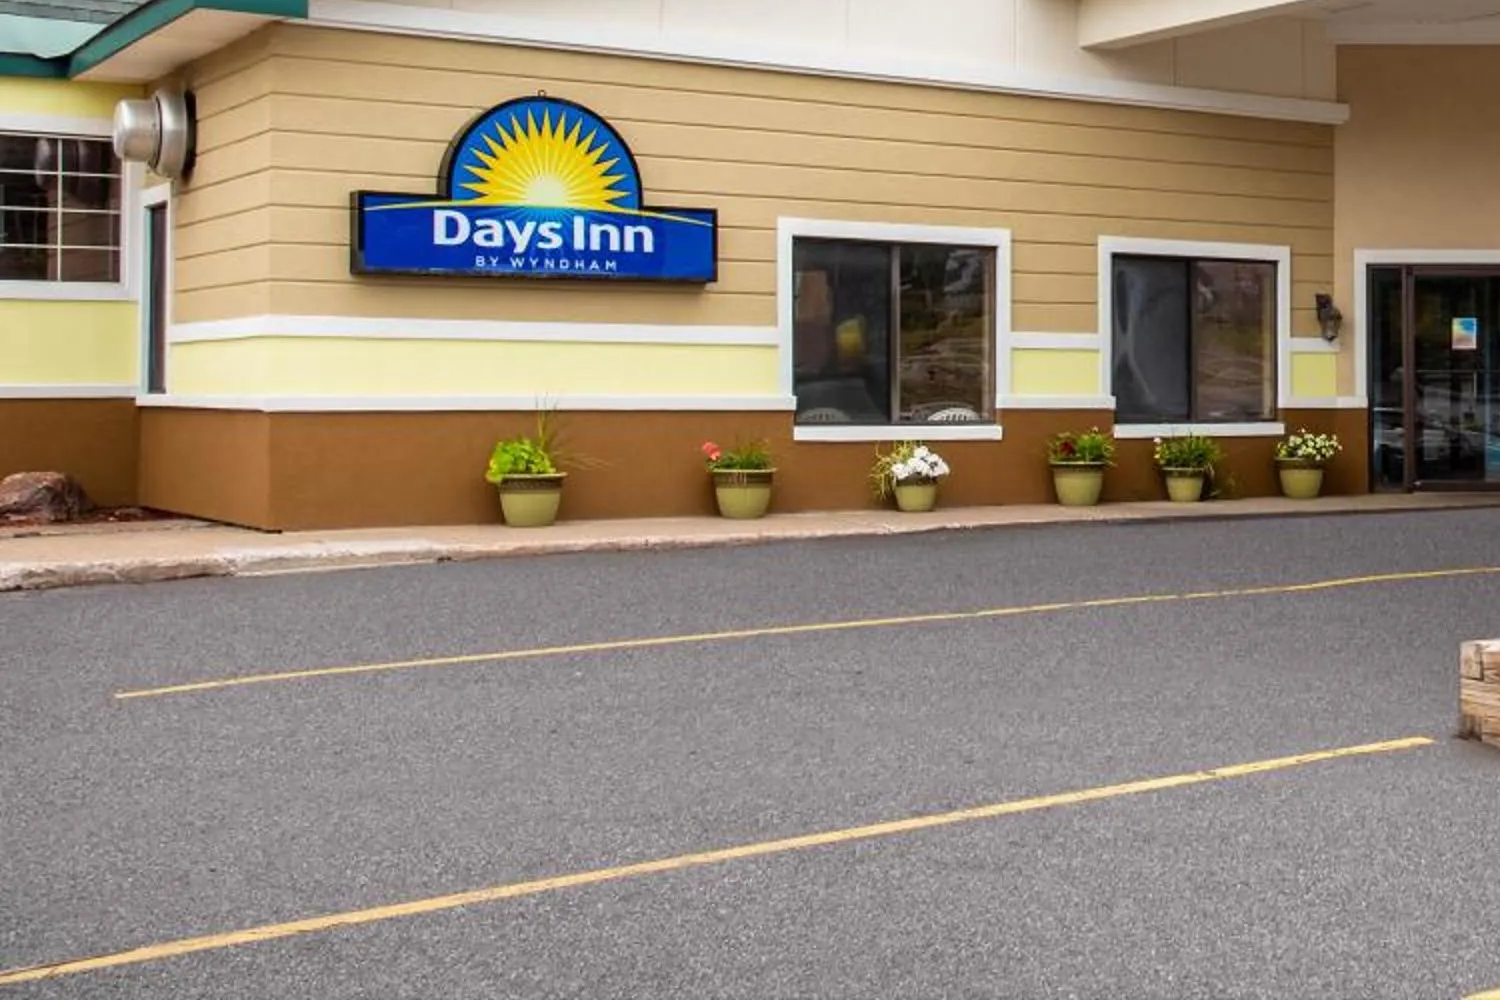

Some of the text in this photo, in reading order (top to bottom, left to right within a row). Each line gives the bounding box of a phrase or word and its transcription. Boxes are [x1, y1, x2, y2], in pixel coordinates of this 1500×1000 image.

[433, 209, 654, 254] Days Inn
[475, 255, 617, 271] BY WYNDHAM
